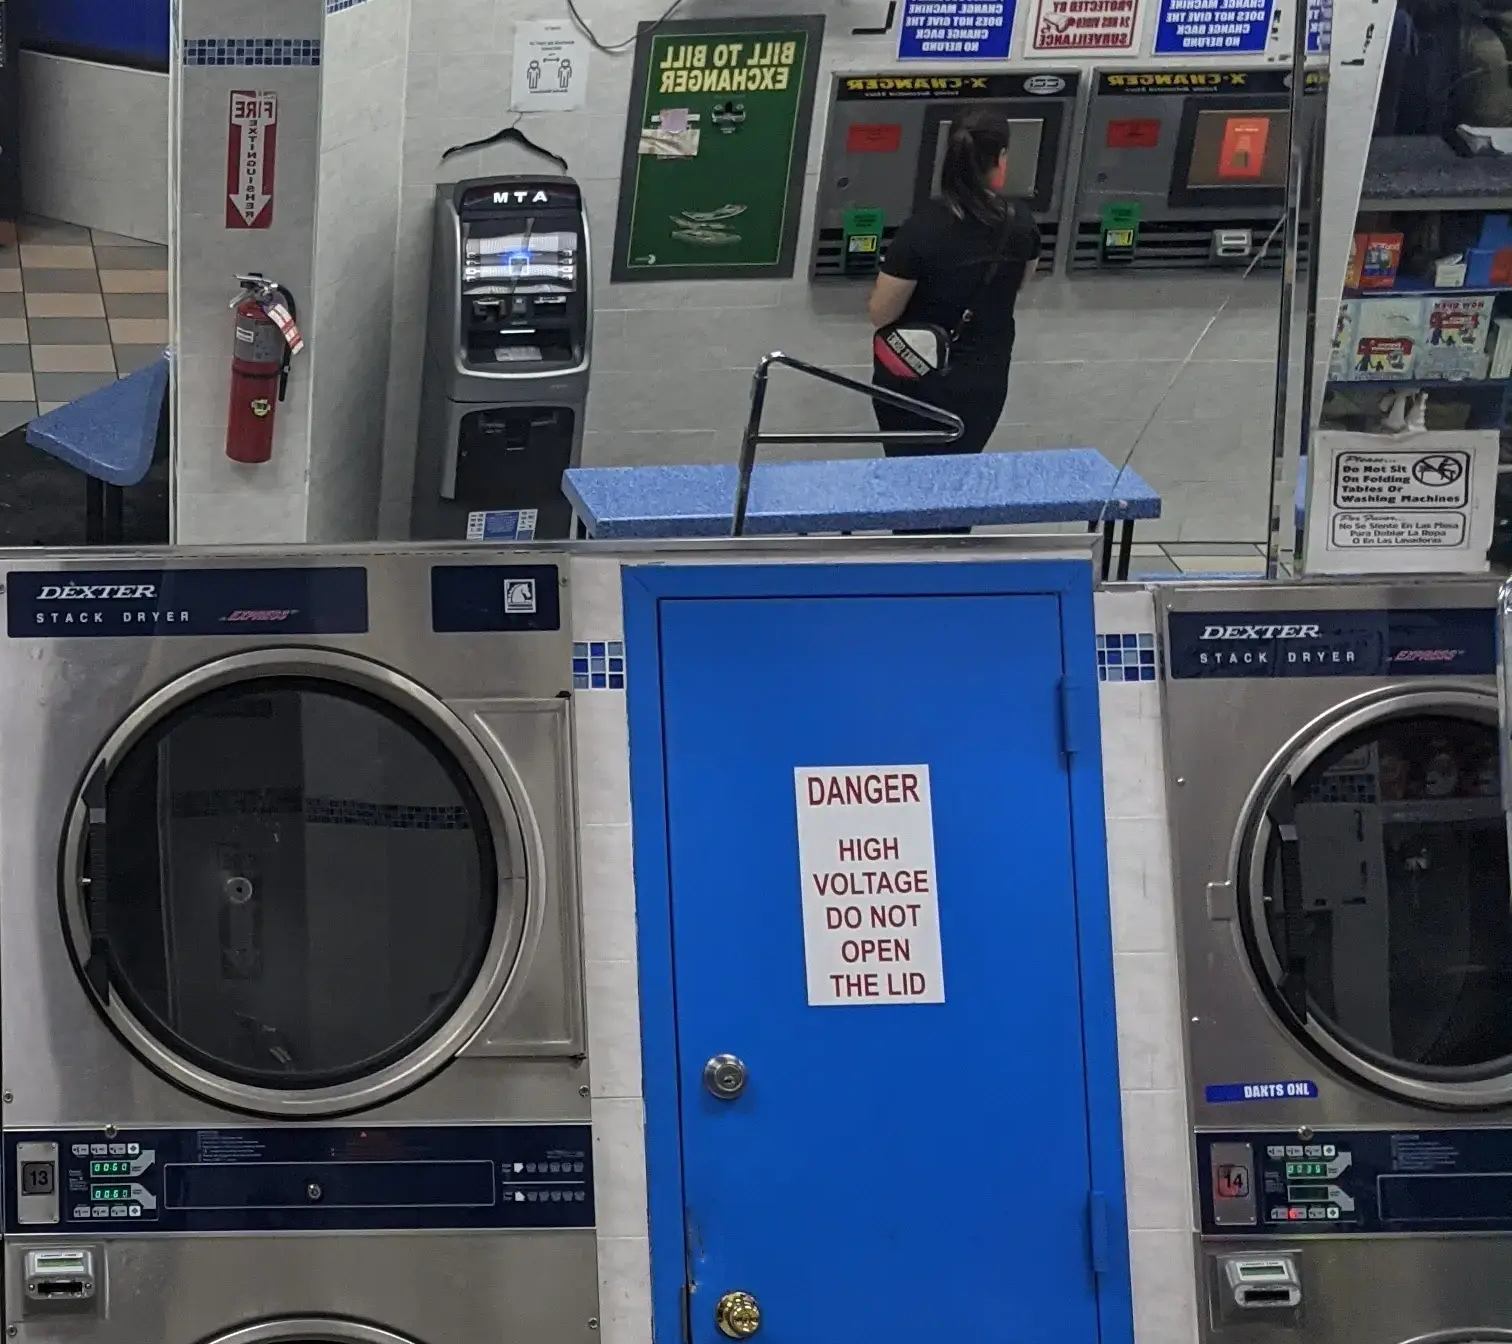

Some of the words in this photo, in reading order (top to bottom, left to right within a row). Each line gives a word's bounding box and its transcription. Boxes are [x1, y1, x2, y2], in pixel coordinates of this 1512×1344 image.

[1363, 465, 1386, 473] Not
[1390, 465, 1407, 473] Sit
[1342, 475, 1360, 483] On
[1363, 475, 1410, 484] Folding
[1342, 485, 1383, 493] Tables
[1388, 485, 1403, 493] Or
[1341, 495, 1396, 504] Washing
[1401, 494, 1460, 503] Machines
[36, 583, 156, 601] DEXTER
[36, 612, 105, 624] STACK
[123, 610, 189, 623] DRYER
[1199, 624, 1320, 641] DEXTER
[1200, 652, 1268, 664] STACK
[1288, 651, 1356, 663] DRYER
[808, 774, 920, 806] DANGER
[839, 837, 899, 861] HIGH
[813, 870, 929, 896] VOLTAGE
[826, 906, 862, 930] DO
[871, 904, 921, 929] NOT
[842, 938, 910, 963] OPEN
[830, 973, 879, 997] THE
[888, 973, 925, 996] LID
[30, 1170, 48, 1186] 13
[1224, 1173, 1243, 1188] 14
